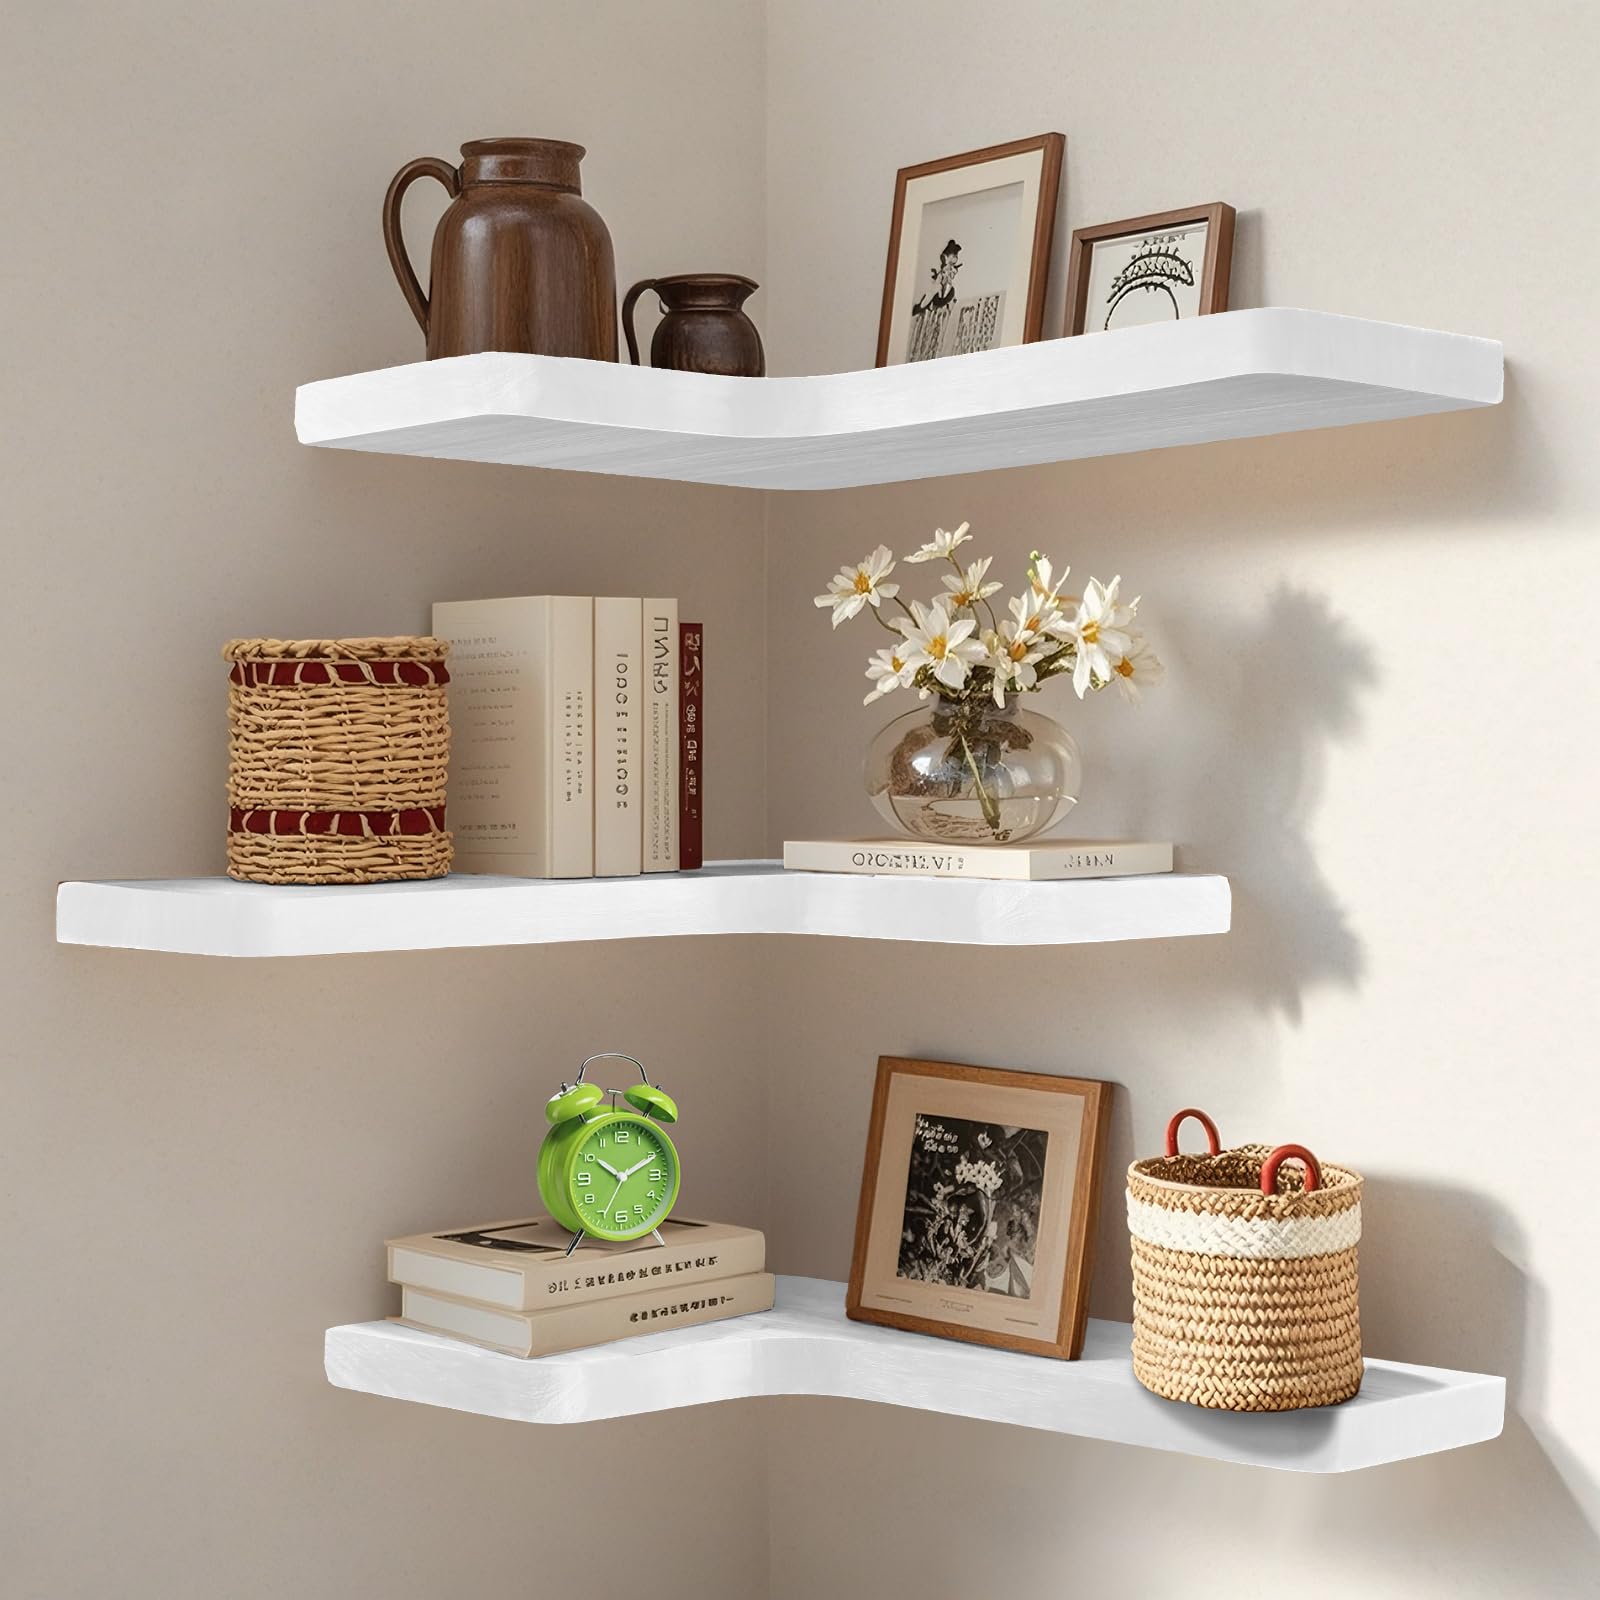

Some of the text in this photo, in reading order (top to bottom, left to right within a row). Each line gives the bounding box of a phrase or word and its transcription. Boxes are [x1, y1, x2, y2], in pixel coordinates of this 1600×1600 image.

[615, 1131, 629, 1142] 12
[600, 1138, 606, 1148] 11
[584, 1153, 596, 1162] 10
[577, 1172, 591, 1185] 9
[649, 1169, 661, 1181] 3
[585, 1193, 595, 1203] 8
[647, 1190, 655, 1198] 4
[633, 1204, 643, 1214] 5
[615, 1210, 628, 1223] 6
